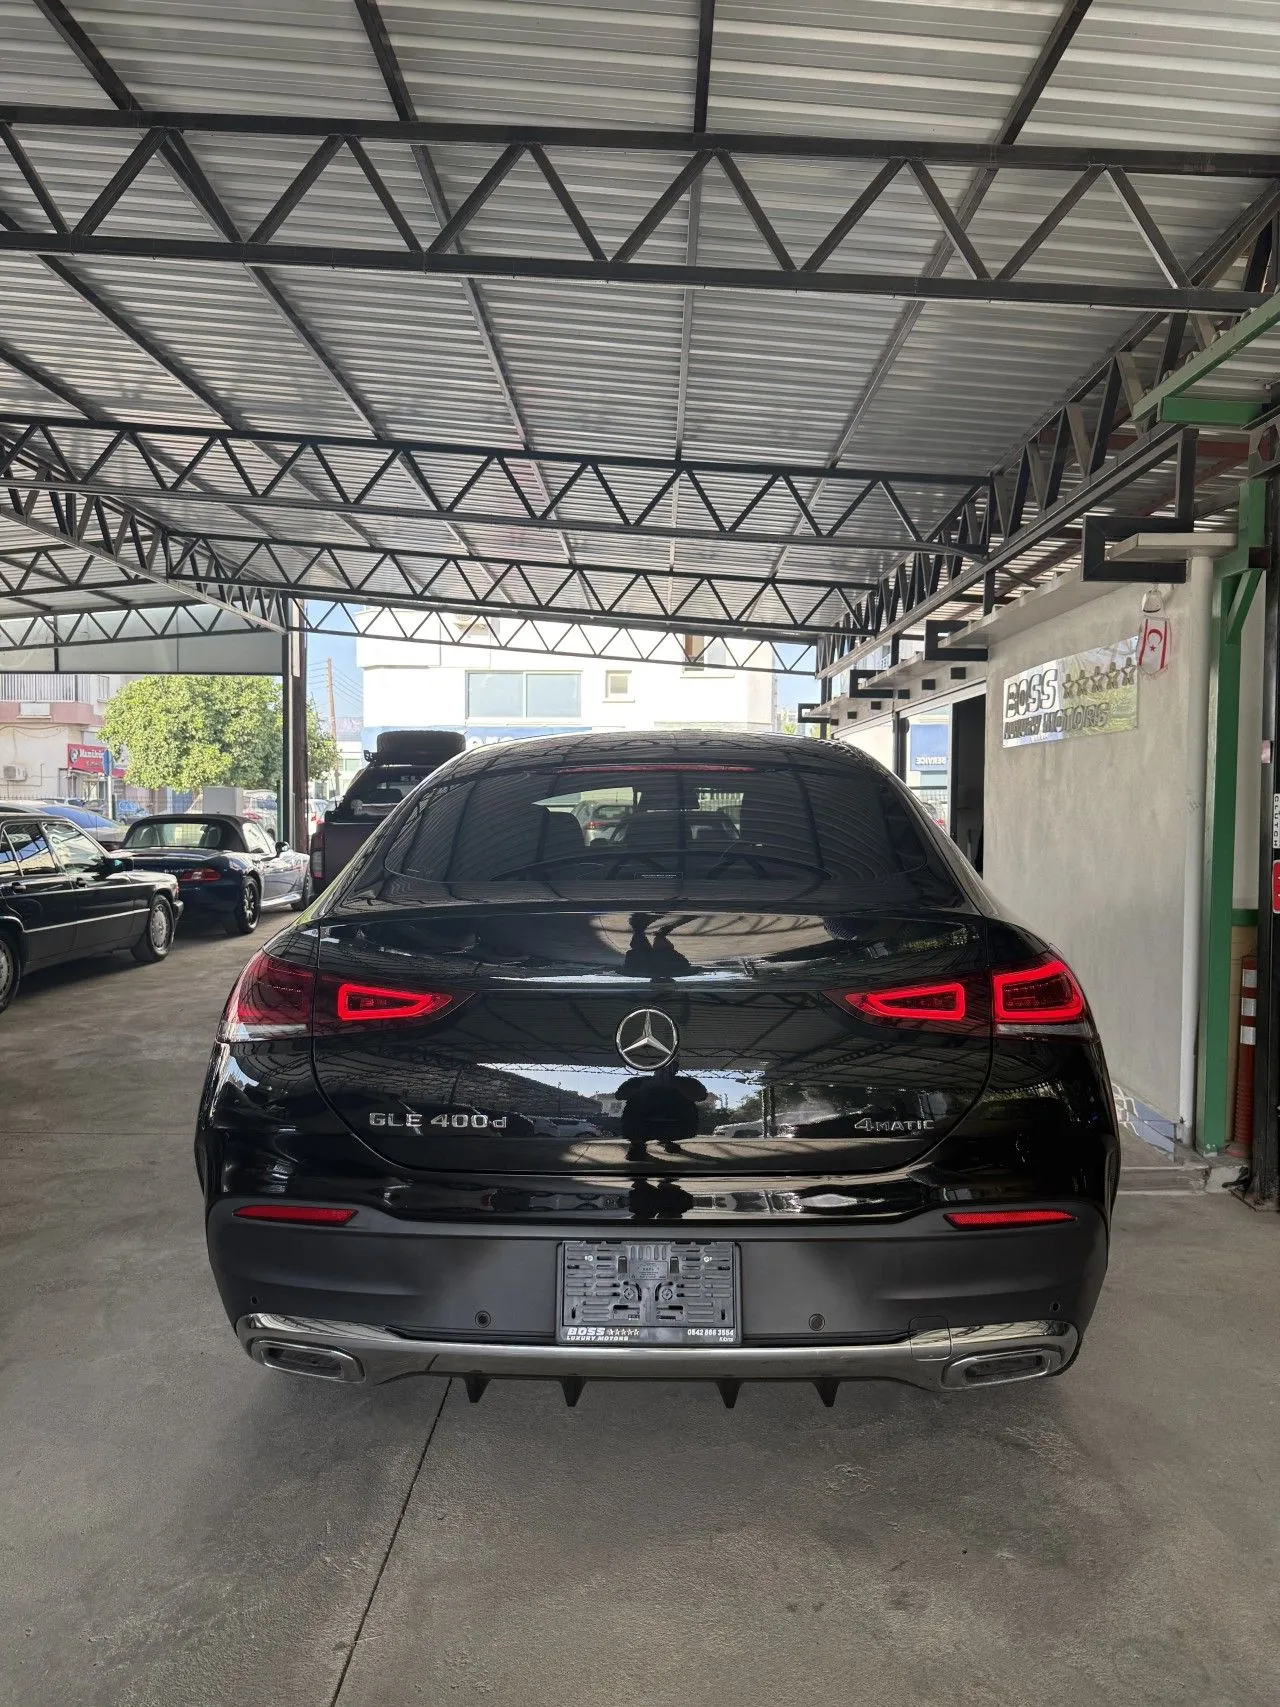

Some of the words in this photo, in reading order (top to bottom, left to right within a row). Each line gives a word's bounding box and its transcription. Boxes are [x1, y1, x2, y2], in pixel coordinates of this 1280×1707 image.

[1006, 669, 1058, 718] BOSS
[369, 1112, 423, 1128] GLE
[854, 1117, 935, 1132] 4MATIC
[567, 1327, 606, 1336] BOSS
